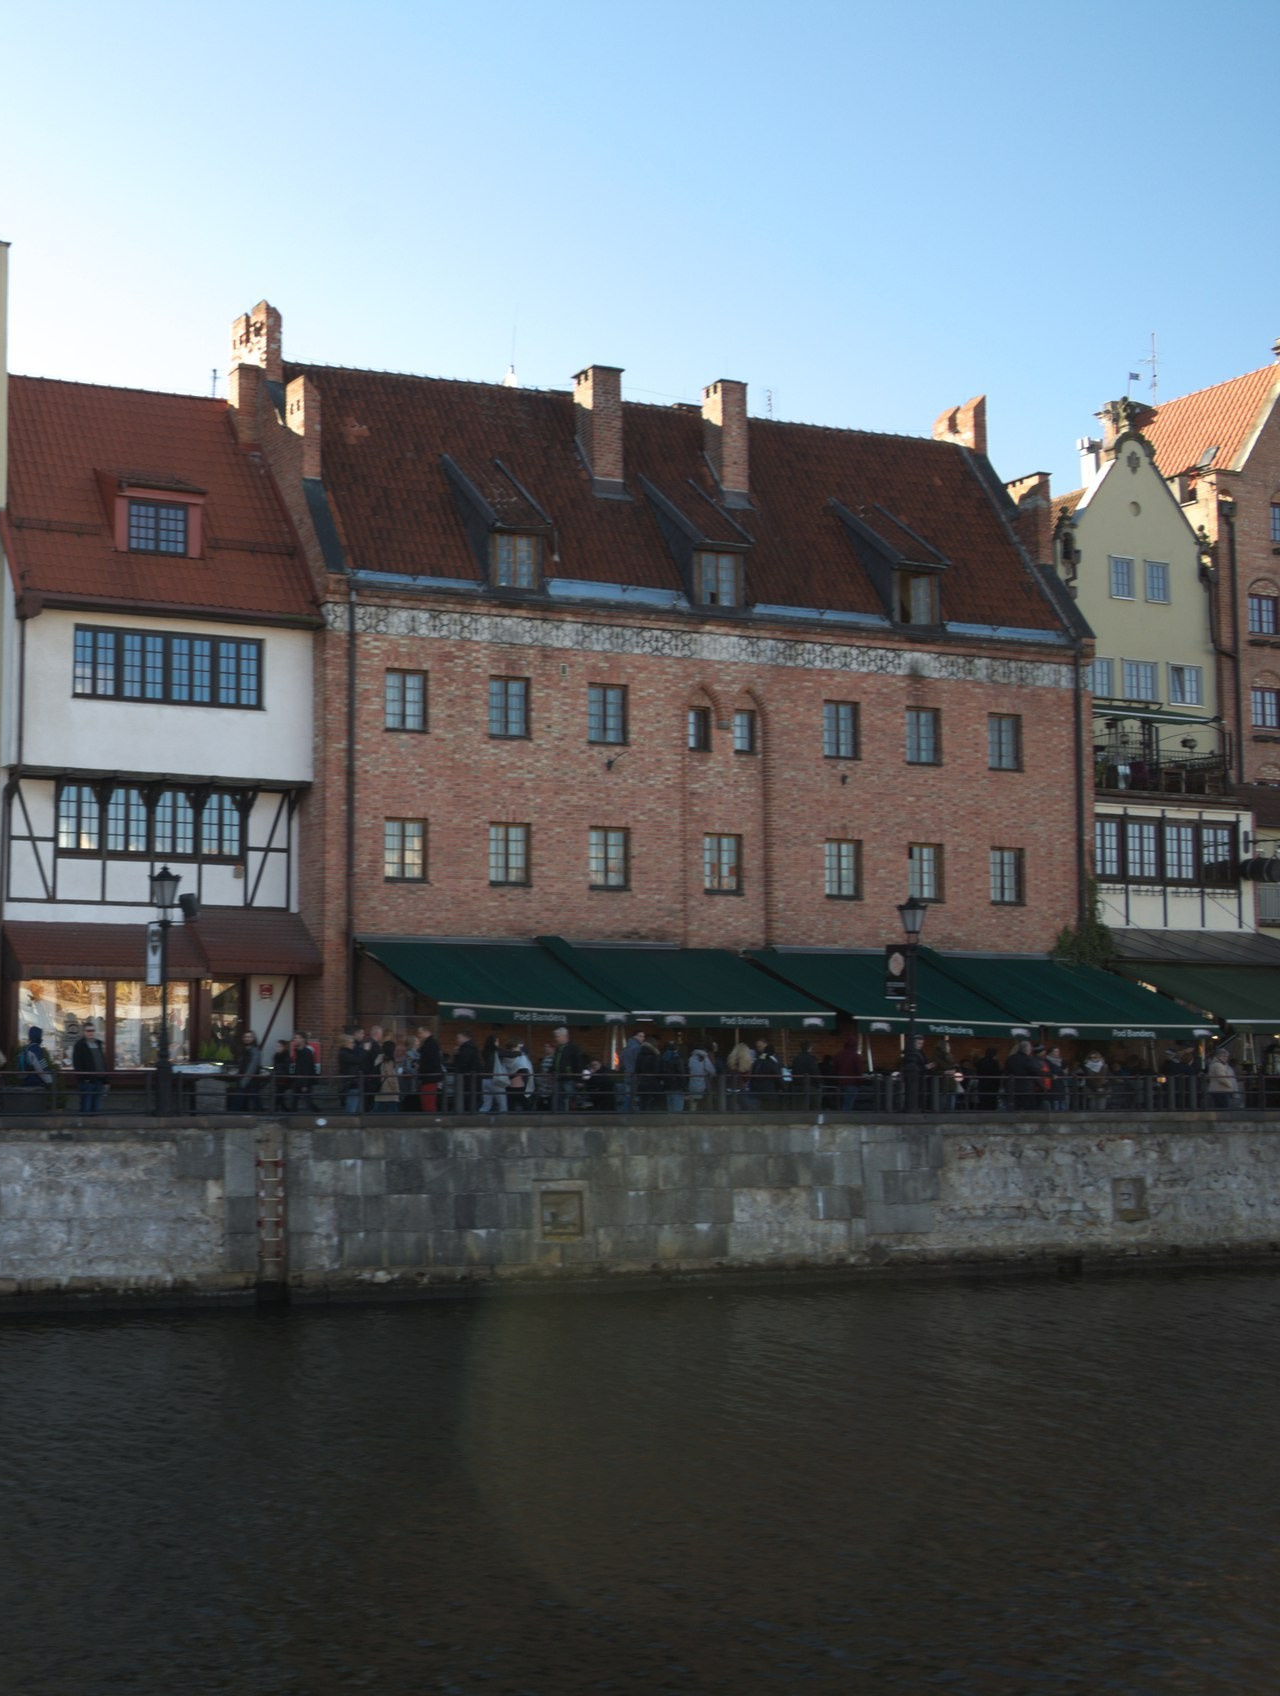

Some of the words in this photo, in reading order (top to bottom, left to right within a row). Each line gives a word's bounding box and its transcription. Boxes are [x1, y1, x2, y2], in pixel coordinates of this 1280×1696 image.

[513, 1011, 531, 1021] Pod
[720, 1015, 736, 1025] Pod
[928, 1024, 944, 1033] Pod
[1112, 1028, 1127, 1038] Pod
